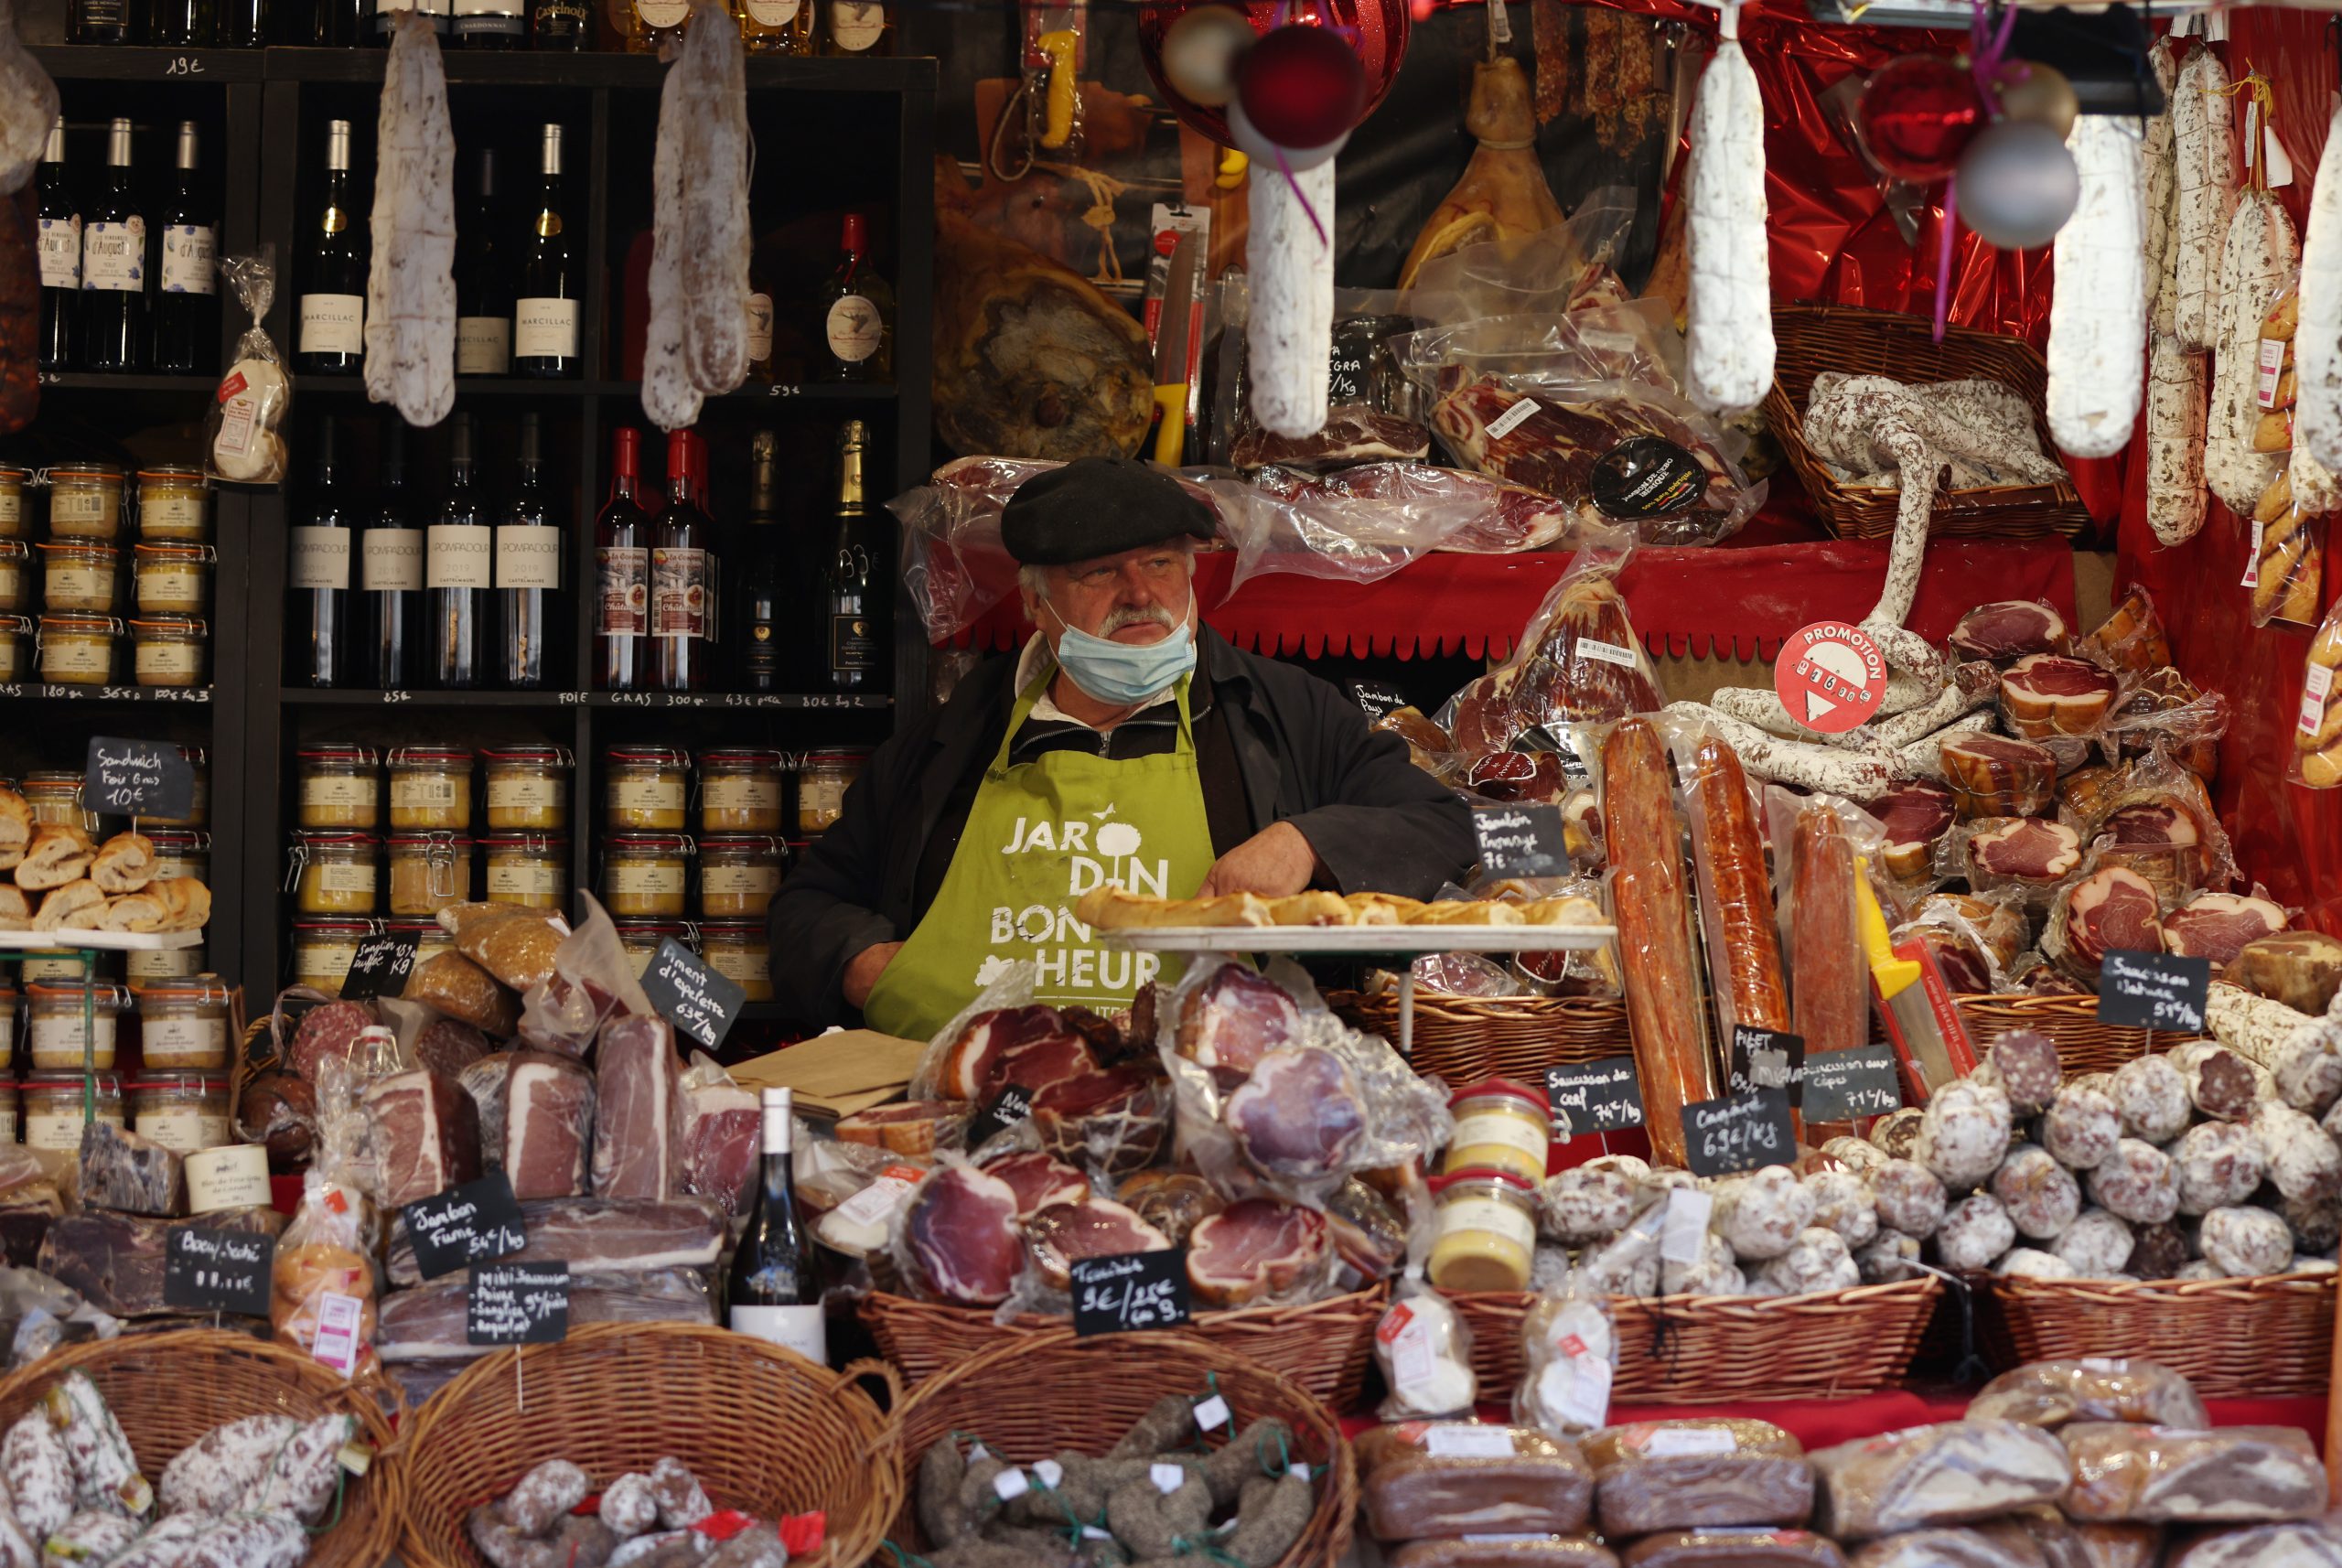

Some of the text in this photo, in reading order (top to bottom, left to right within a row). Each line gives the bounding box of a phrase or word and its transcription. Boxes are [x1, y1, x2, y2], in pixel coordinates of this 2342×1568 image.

[166, 57, 204, 75] 19€
[1803, 626, 1882, 680] PROMOTION
[43, 685, 65, 696] 180
[611, 693, 651, 707] GRAS
[666, 695, 691, 706] 300
[725, 693, 751, 706] 43€
[854, 696, 864, 707] 2
[1355, 684, 1405, 705] Jambon de
[1360, 698, 1383, 716] Pays
[97, 748, 161, 771] Sandwich
[102, 769, 160, 787] Foie Gras
[106, 787, 145, 805] 10€
[1002, 817, 1090, 854] JAR
[991, 904, 1090, 944] BON
[663, 944, 707, 987] Piment
[1035, 949, 1161, 990] HEUR
[1613, 1069, 1630, 1081] de
[414, 1202, 477, 1231] Jambon
